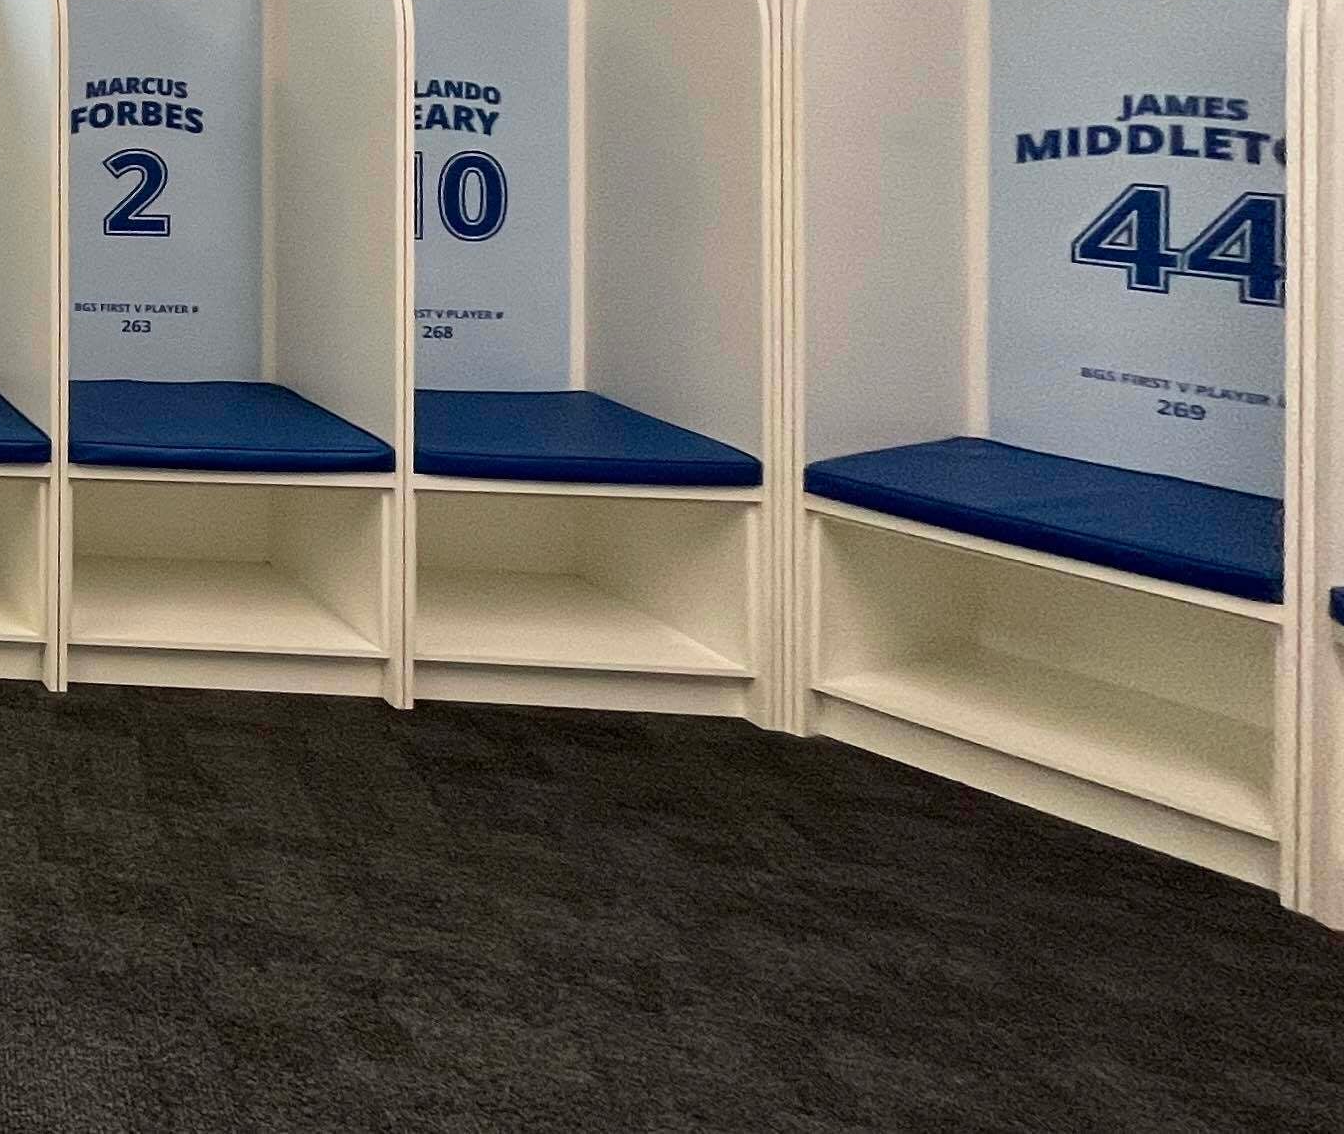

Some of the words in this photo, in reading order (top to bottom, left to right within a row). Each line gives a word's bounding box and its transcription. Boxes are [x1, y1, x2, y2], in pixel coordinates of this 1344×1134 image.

[85, 77, 188, 99] MARCUS
[71, 100, 204, 134] FORBES
[1116, 94, 1249, 122] JAMES
[102, 147, 171, 237] 2
[1071, 183, 1286, 308] 44
[74, 302, 97, 311] BGS
[100, 303, 130, 312] FIRST
[134, 304, 142, 313] V
[145, 304, 189, 313] PLAYER
[436, 310, 444, 319] V
[447, 310, 492, 319] PLAYER
[121, 320, 151, 333] 263
[423, 326, 453, 339] 268
[1080, 366, 1115, 382] BGS
[1122, 373, 1168, 390] FIRST
[1176, 381, 1194, 393] V
[1197, 384, 1269, 406] PLAYER
[1157, 399, 1206, 421] 269
